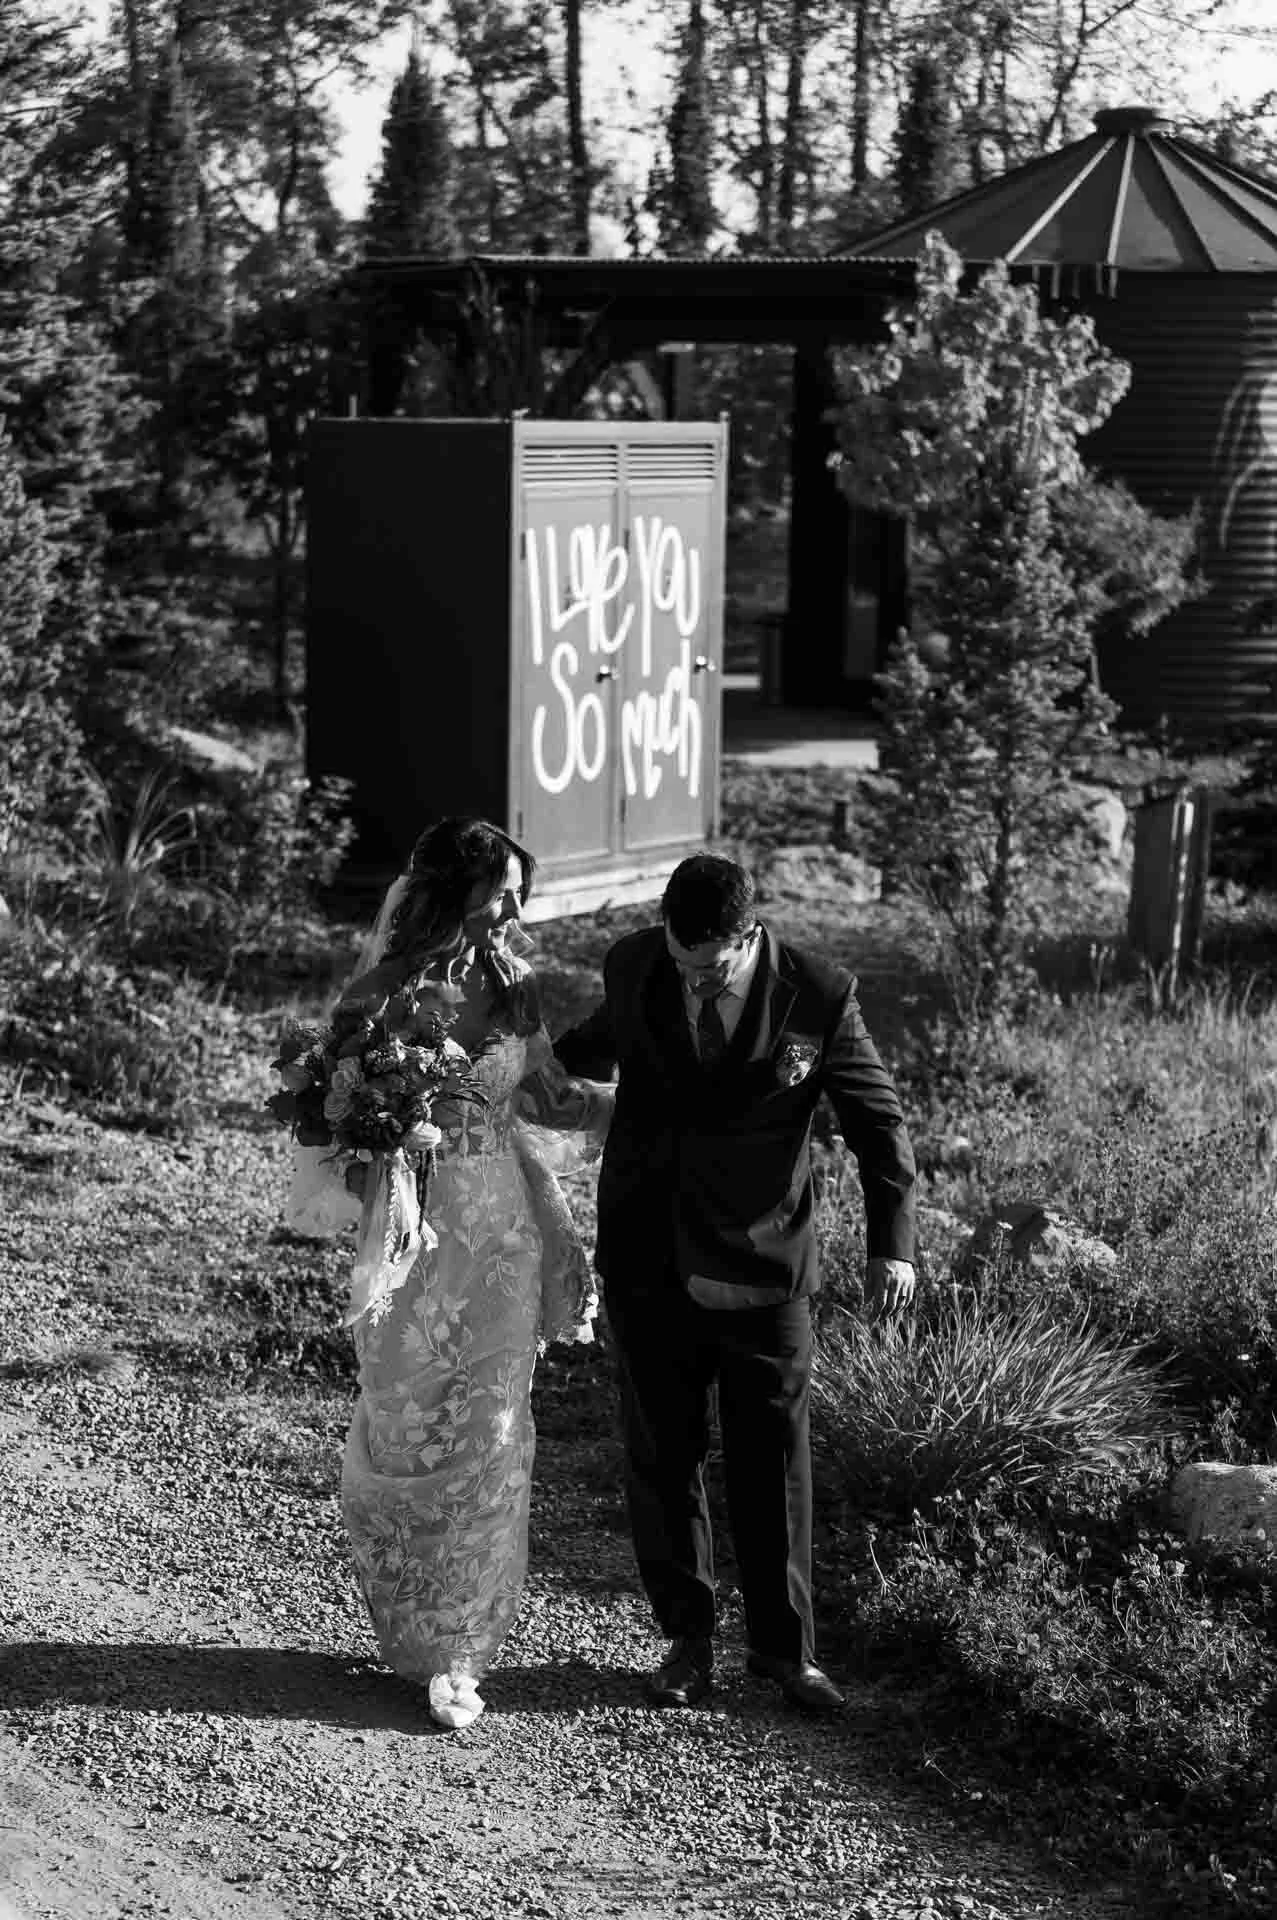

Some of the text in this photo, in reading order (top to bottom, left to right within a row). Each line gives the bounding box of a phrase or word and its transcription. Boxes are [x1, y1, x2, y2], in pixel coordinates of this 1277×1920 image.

[526, 516, 700, 677] I Love You
[532, 642, 606, 793] So
